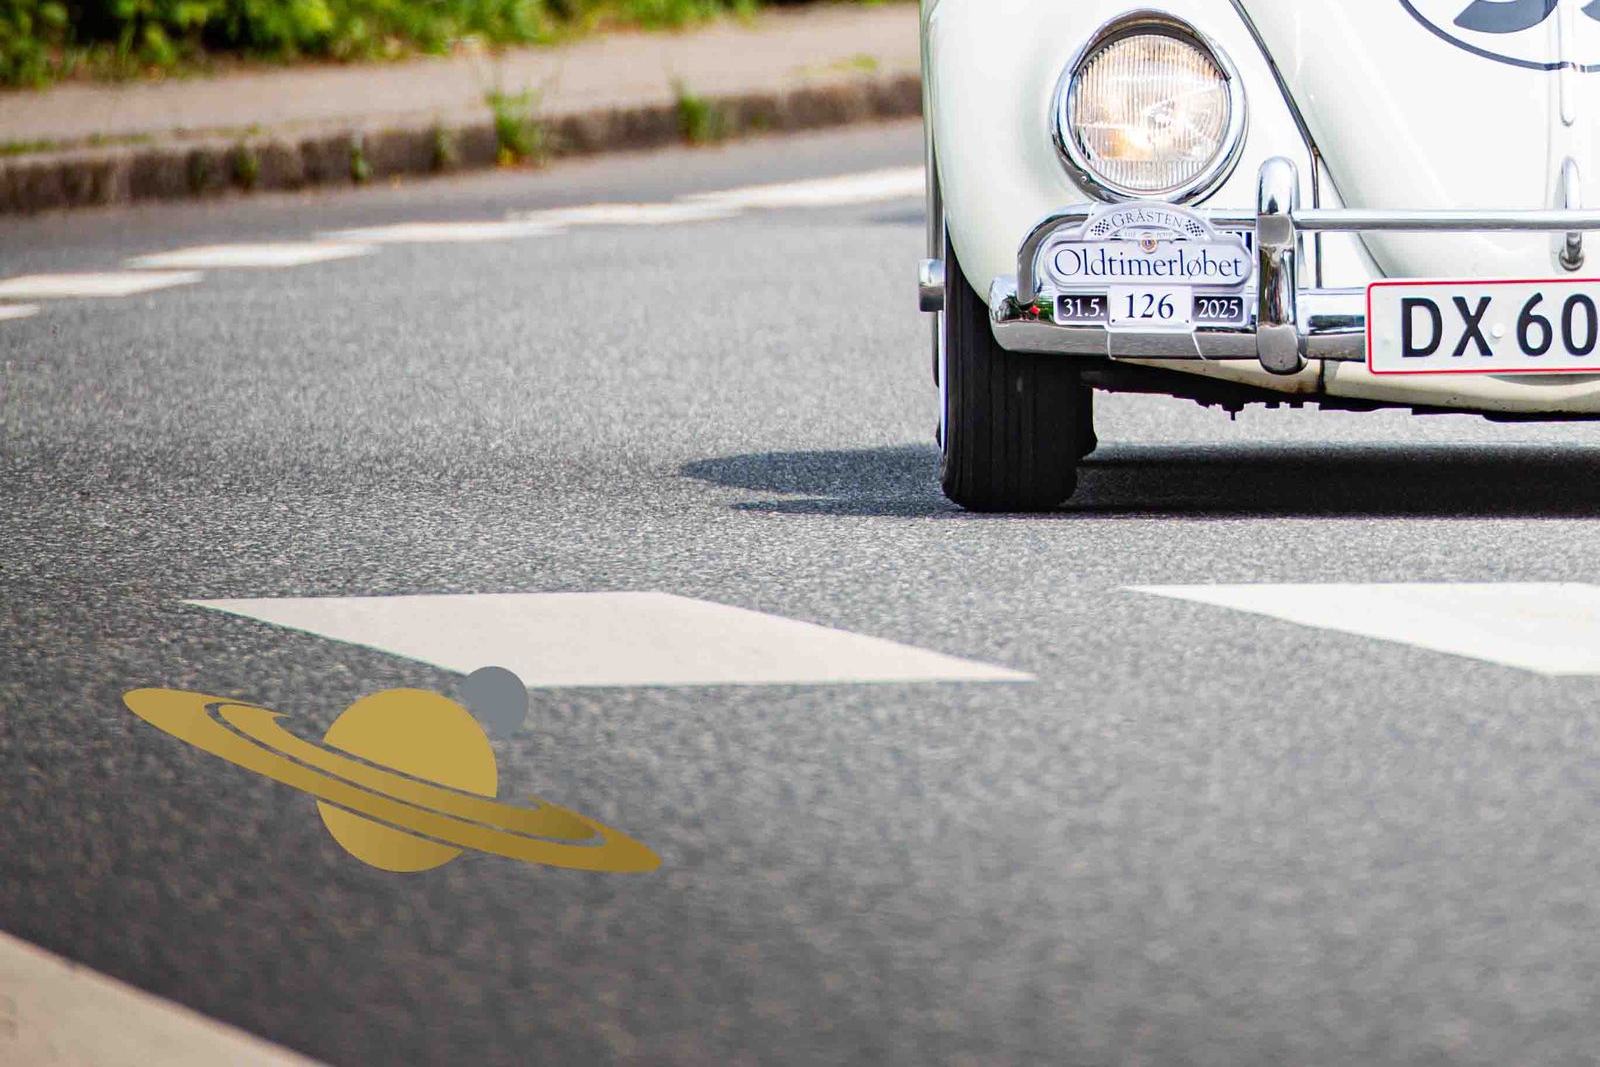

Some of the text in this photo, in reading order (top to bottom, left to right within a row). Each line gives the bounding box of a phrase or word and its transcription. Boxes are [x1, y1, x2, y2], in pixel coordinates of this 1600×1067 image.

[1111, 208, 1183, 228] GRÅSTEN
[1054, 248, 1243, 279] Oldtimerløbet
[1063, 298, 1104, 317] 31.5.
[1126, 293, 1174, 319] 126
[1198, 299, 1239, 318] 2025
[1400, 295, 1494, 358] DX
[1516, 292, 1599, 357] 60
